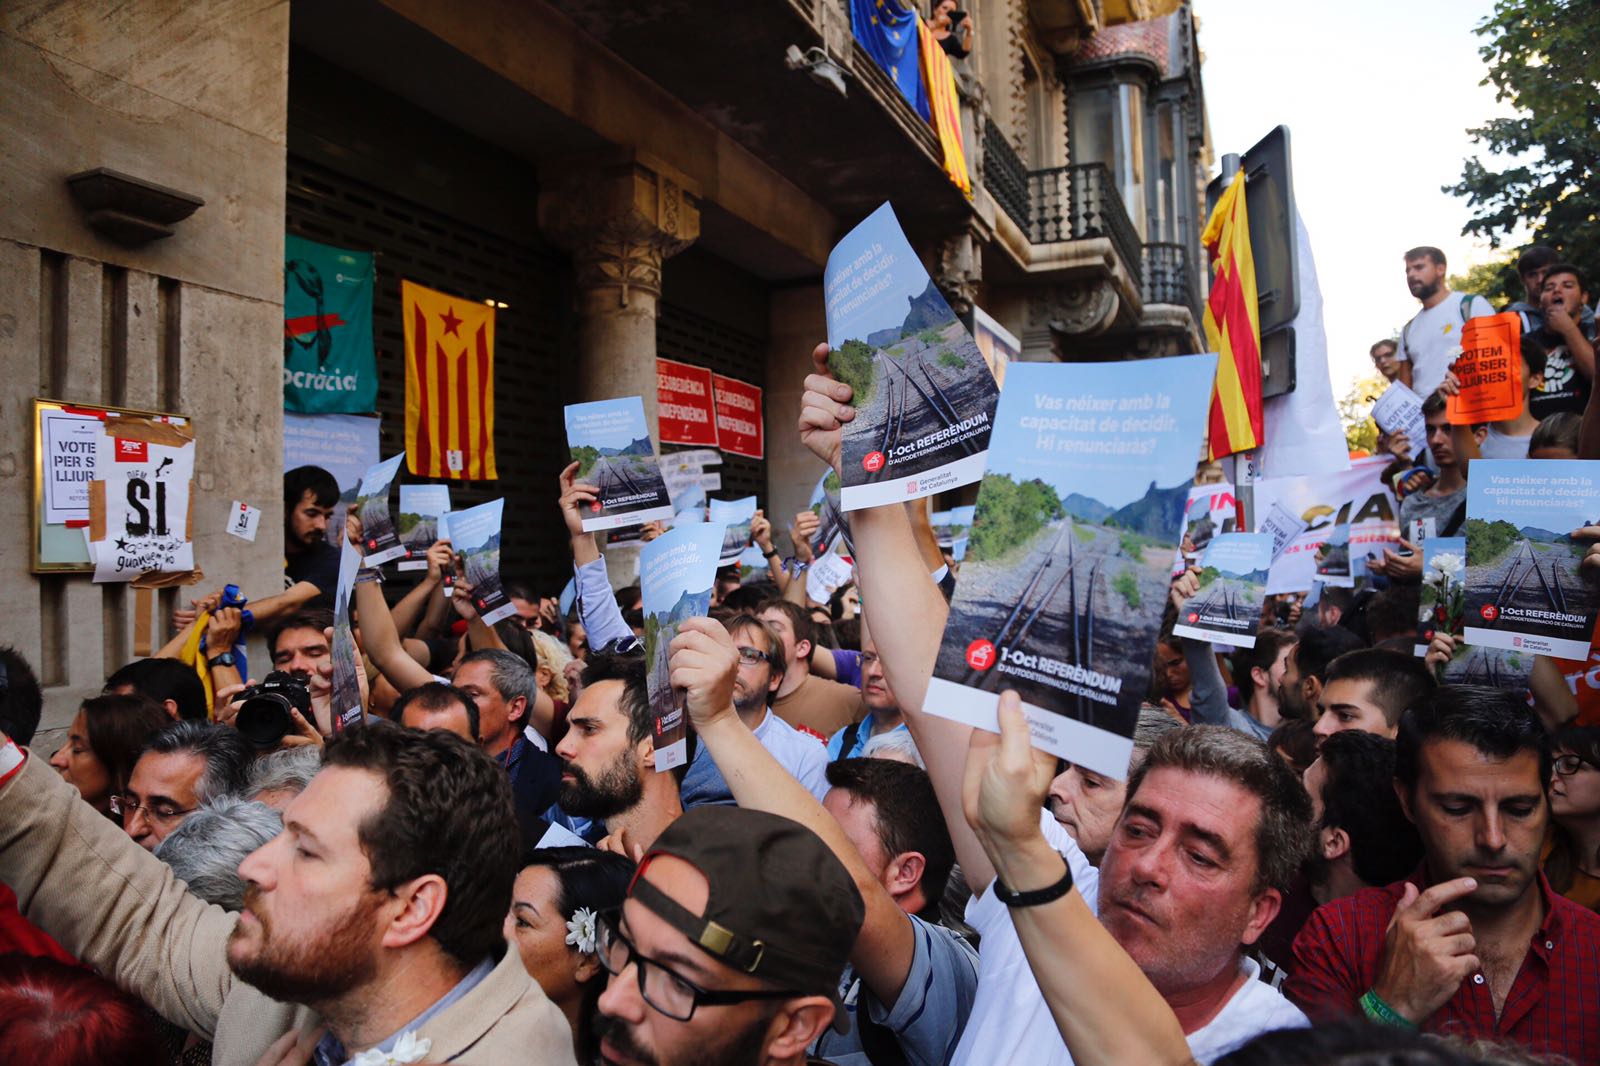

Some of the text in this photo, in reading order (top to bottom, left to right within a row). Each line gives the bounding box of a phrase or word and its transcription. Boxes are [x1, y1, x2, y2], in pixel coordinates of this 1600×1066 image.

[853, 250, 874, 269] amb
[872, 243, 883, 255] la
[851, 277, 863, 289] de
[1479, 357, 1508, 372] SER
[1034, 393, 1063, 410] Vas
[1119, 394, 1153, 411] amb
[1156, 392, 1171, 409] la
[1020, 414, 1180, 433] capacitat de decidir.
[888, 411, 989, 459] 1-Oct REFERÈNDUM
[950, 436, 960, 445] DE
[960, 424, 991, 441] CATALUNYA
[59, 441, 96, 454] VOTE
[1035, 434, 1056, 451] Hi
[54, 455, 95, 468] PER S
[56, 470, 95, 482] LLIUR
[920, 471, 952, 486] Generalitat
[928, 477, 958, 489] Catalunya
[1490, 475, 1511, 486] Vas
[1551, 475, 1578, 486] amb
[1580, 476, 1592, 487] la
[1483, 486, 1531, 497] capacitat
[1533, 487, 1551, 496] de
[1496, 497, 1510, 506] Hi
[1500, 607, 1587, 624] 1-Oct REFERÈNDUM
[1001, 646, 1123, 694] 1-Oct REFERÈNDUM
[1069, 684, 1079, 695] DE
[1078, 686, 1118, 706] CATALUNYA
